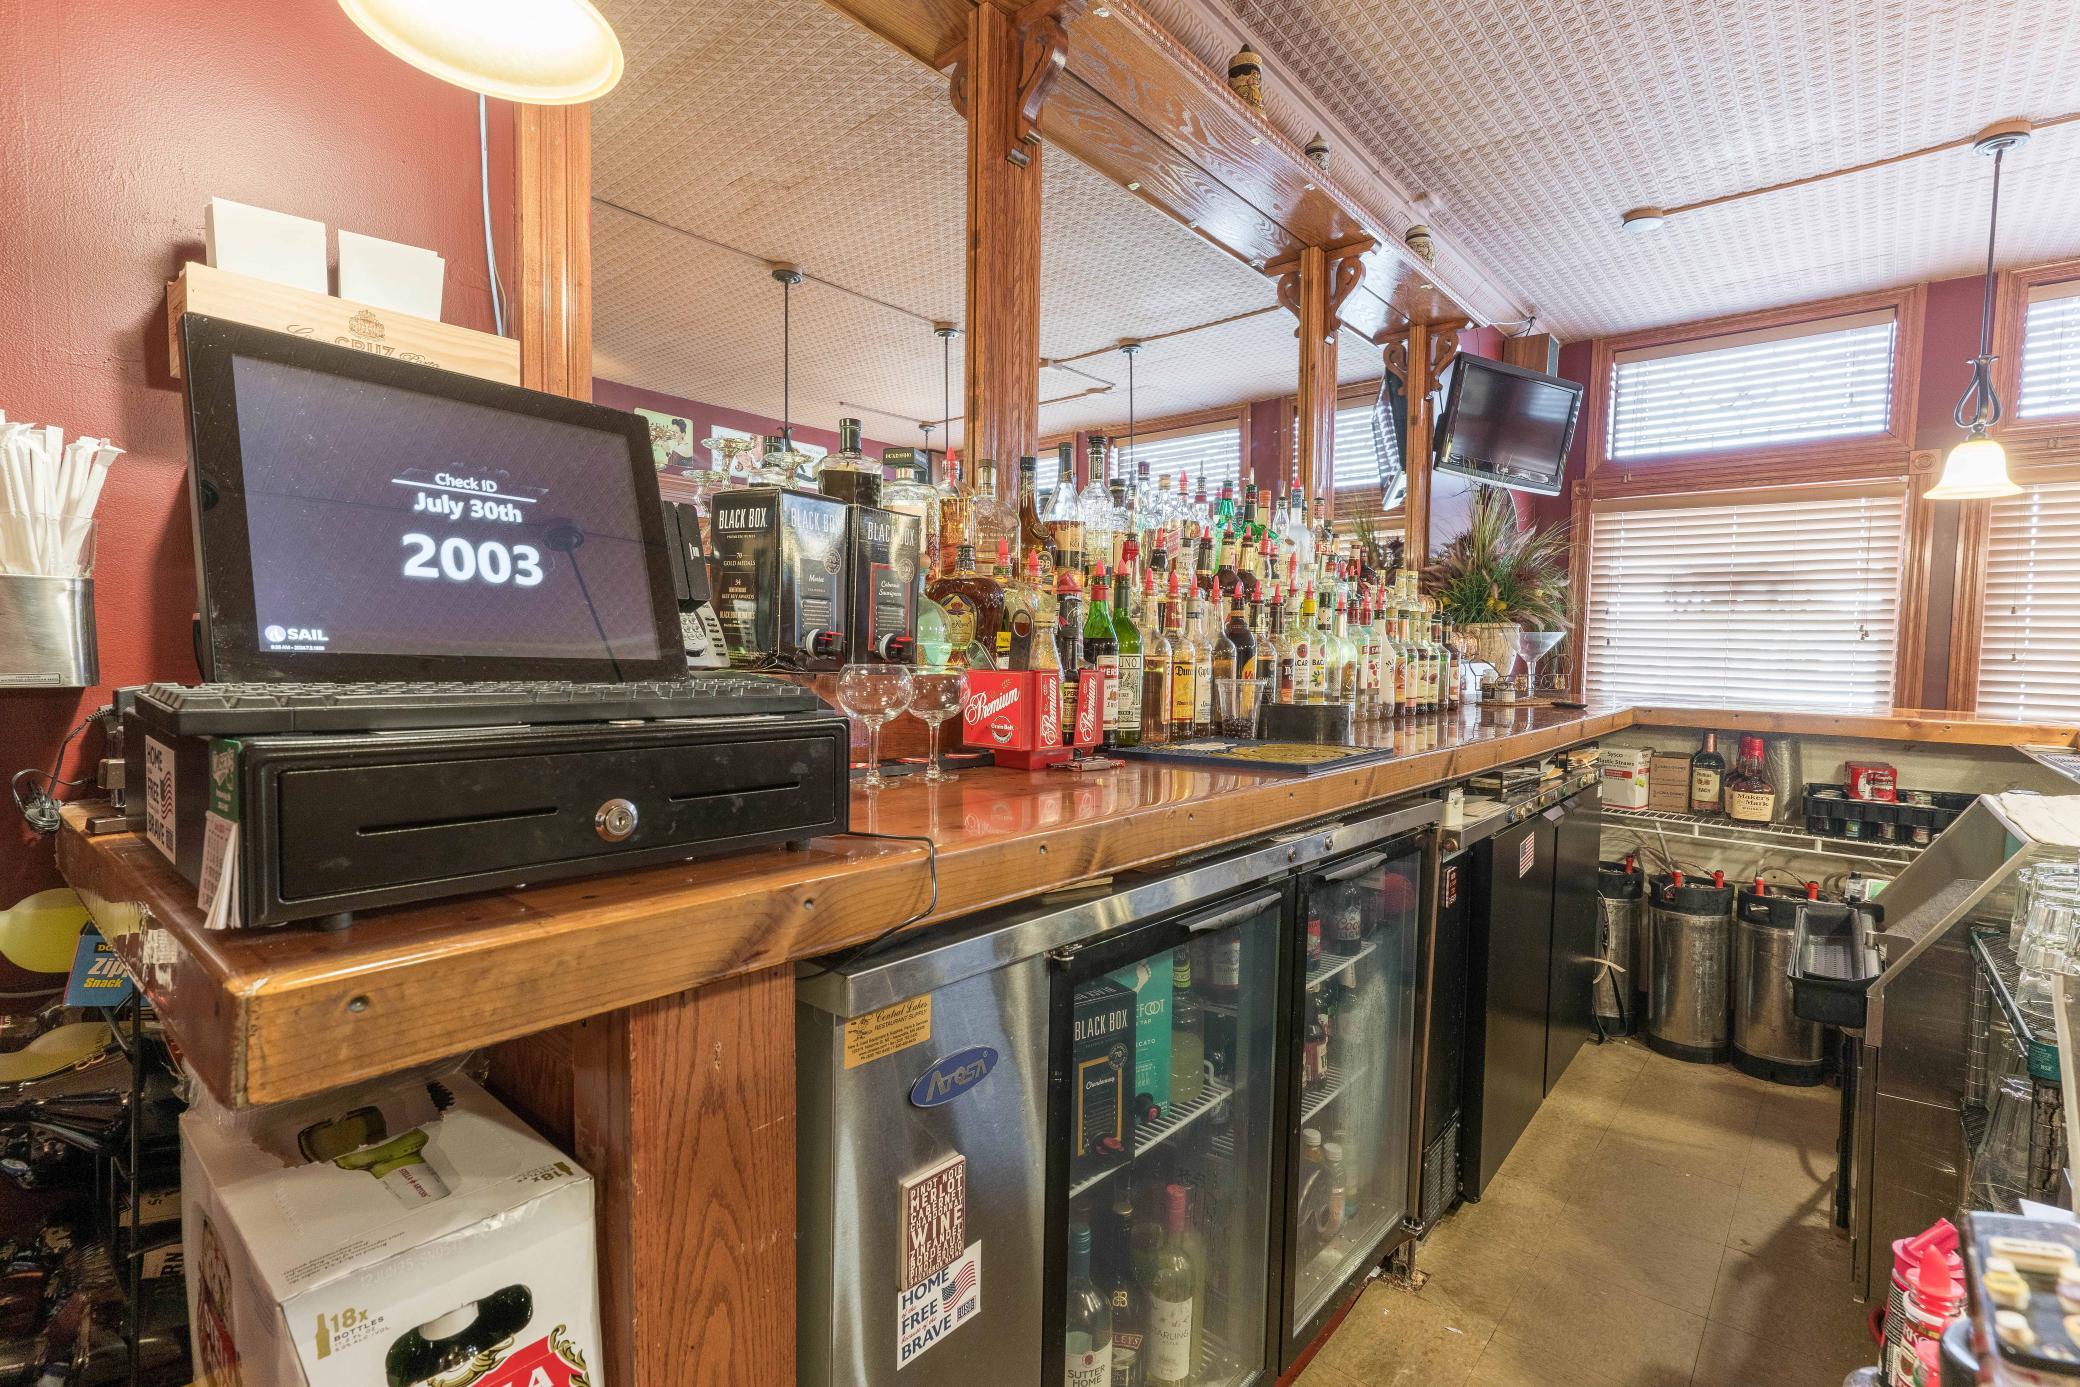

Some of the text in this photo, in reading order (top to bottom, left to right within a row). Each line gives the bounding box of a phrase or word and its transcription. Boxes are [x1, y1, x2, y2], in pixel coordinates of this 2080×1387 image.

[434, 472, 498, 492] Check ID
[413, 491, 523, 523] July 30th
[718, 508, 747, 529] BLACK
[791, 507, 820, 531] BLACK
[867, 521, 897, 542] BLAC
[402, 532, 544, 586] 2003
[287, 627, 330, 641] SAIL
[964, 687, 1020, 726] Premium
[1041, 676, 1058, 745] Premium
[1080, 676, 1097, 742] Premium
[147, 777, 160, 804] FREE
[1737, 793, 1770, 801] Maker's
[88, 957, 130, 978] Zip
[83, 977, 123, 988] Snack
[874, 1009, 928, 1031] RESTAURANT SUPPLY
[875, 999, 928, 1022] Central Lakes
[1074, 1009, 1128, 1041] BLACK BOX
[910, 1164, 963, 1200] PINOT NOIR
[910, 1174, 962, 1214] MERLOT
[910, 1186, 963, 1224] CABERNET
[910, 1196, 963, 1232] CHARDONNAY
[910, 1222, 963, 1261] ZINFANDEL
[911, 1205, 963, 1250] WINE
[910, 1230, 962, 1271] BORDEAUX
[910, 1258, 933, 1281] PINOT
[902, 1266, 950, 1310] HOME
[330, 1307, 368, 1333] 18x
[334, 1316, 384, 1342] BOTTLES
[902, 1298, 938, 1335] FREE
[901, 1313, 952, 1362] BRAVE
[1067, 1363, 1106, 1380] SUTTER
[1072, 1374, 1103, 1387] HOME
